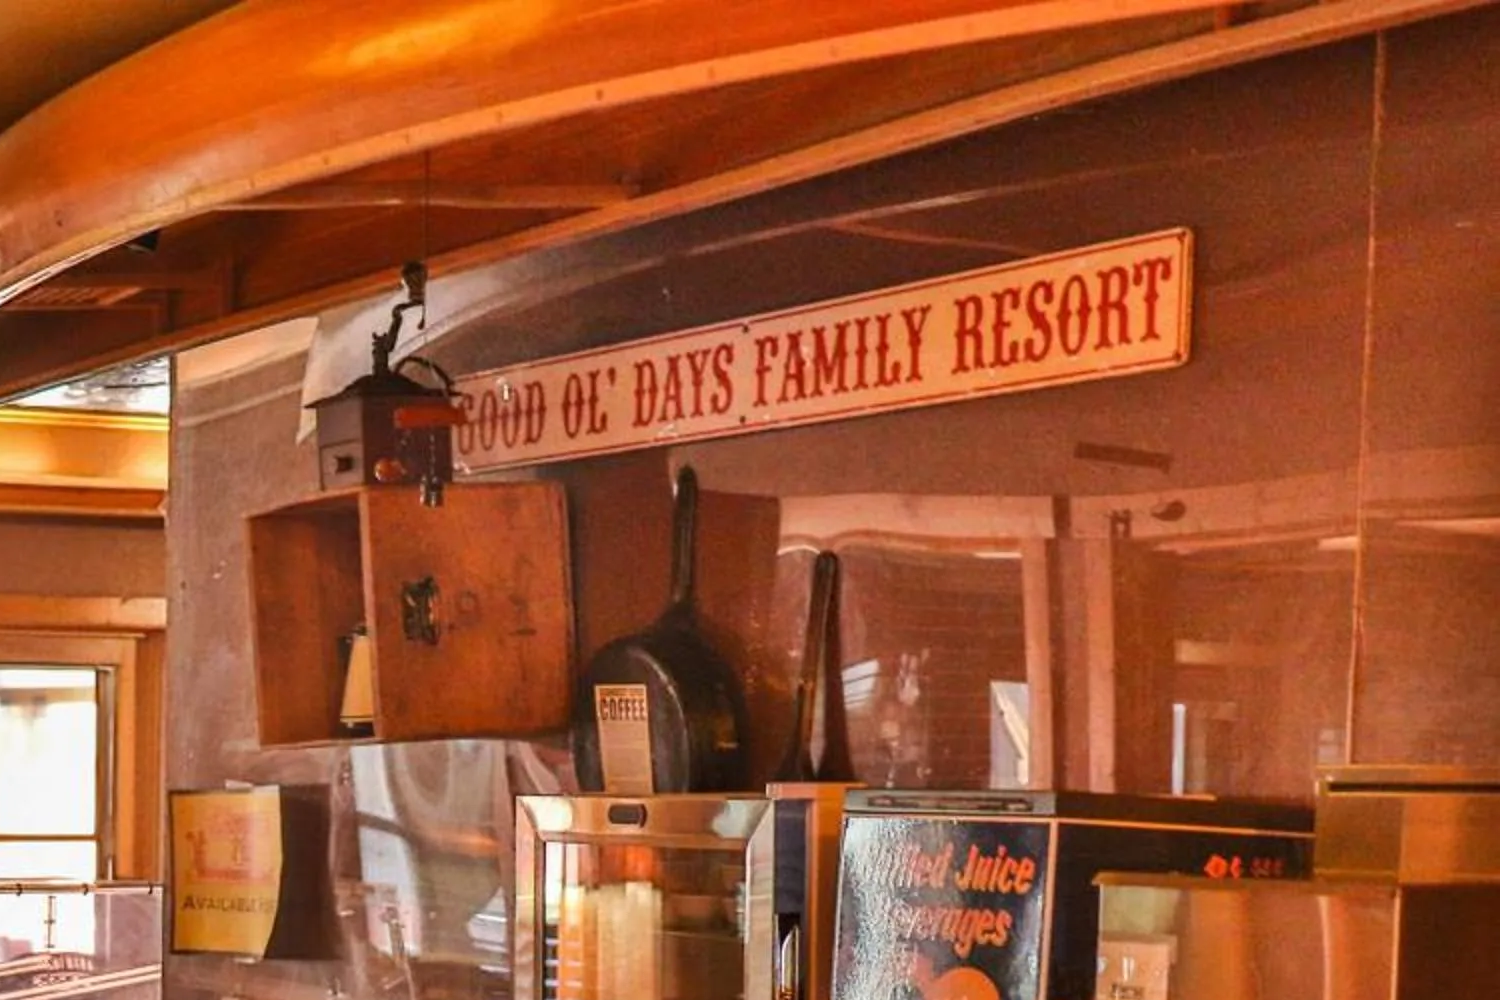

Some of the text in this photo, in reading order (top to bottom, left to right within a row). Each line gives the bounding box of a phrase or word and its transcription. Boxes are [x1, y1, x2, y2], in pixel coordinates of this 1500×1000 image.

[457, 254, 1173, 455] GOOD OL' DAYS FAMILY RESORT
[599, 697, 647, 721] COFFEE
[954, 843, 1037, 894] Juice
[876, 897, 1013, 959] everages
